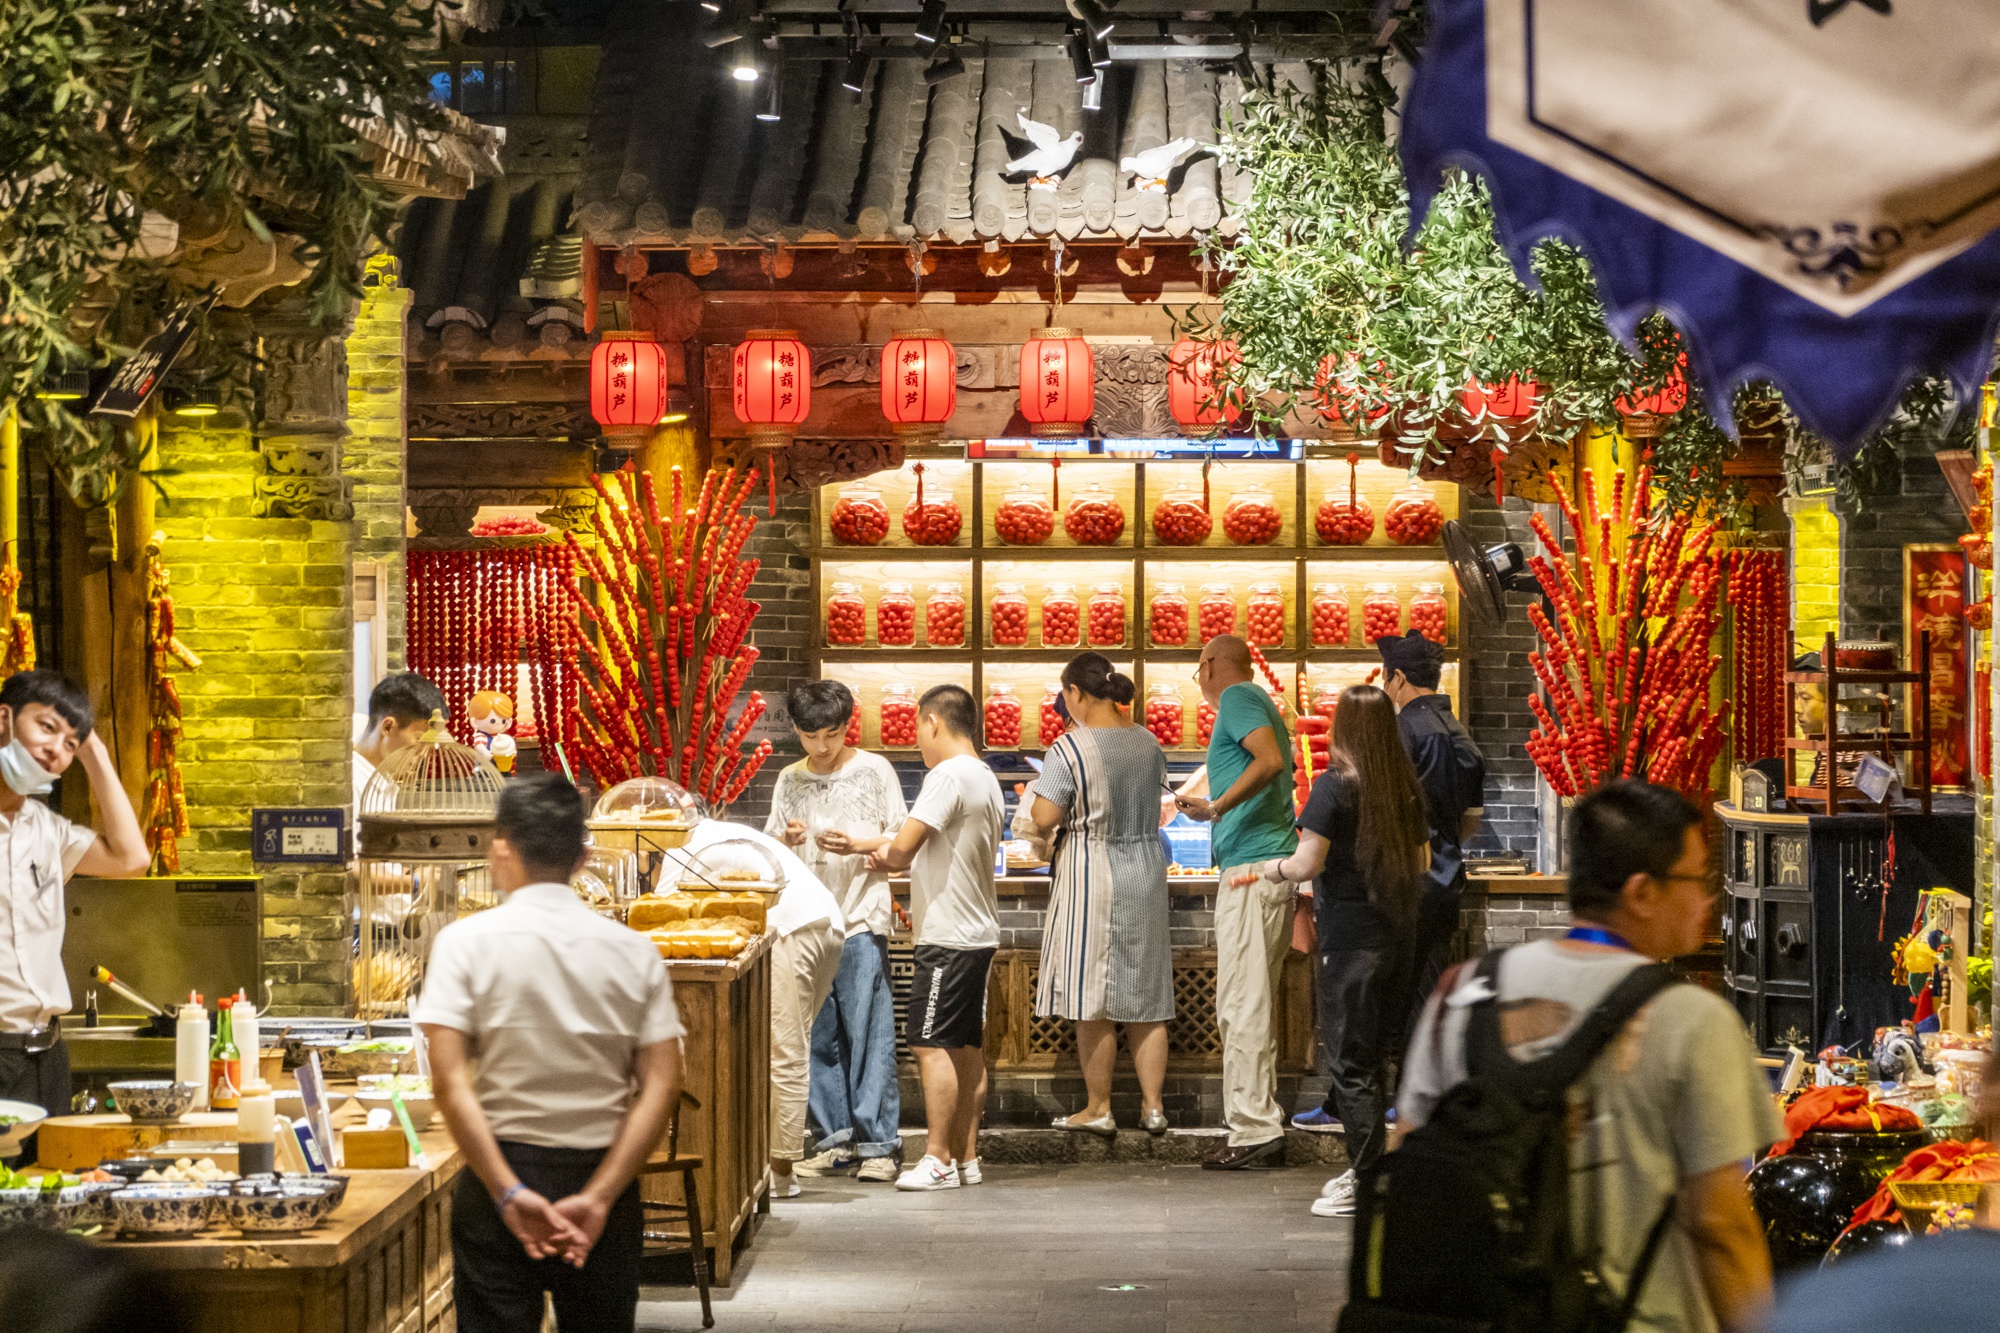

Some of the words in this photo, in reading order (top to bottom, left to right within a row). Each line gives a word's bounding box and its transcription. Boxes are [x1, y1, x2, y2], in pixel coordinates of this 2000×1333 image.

[610, 352, 628, 411] 糖葫芦
[778, 351, 795, 411] 糖葫芦
[902, 350, 920, 410] 糖葫芦
[1042, 349, 1061, 409] 糖葫芦
